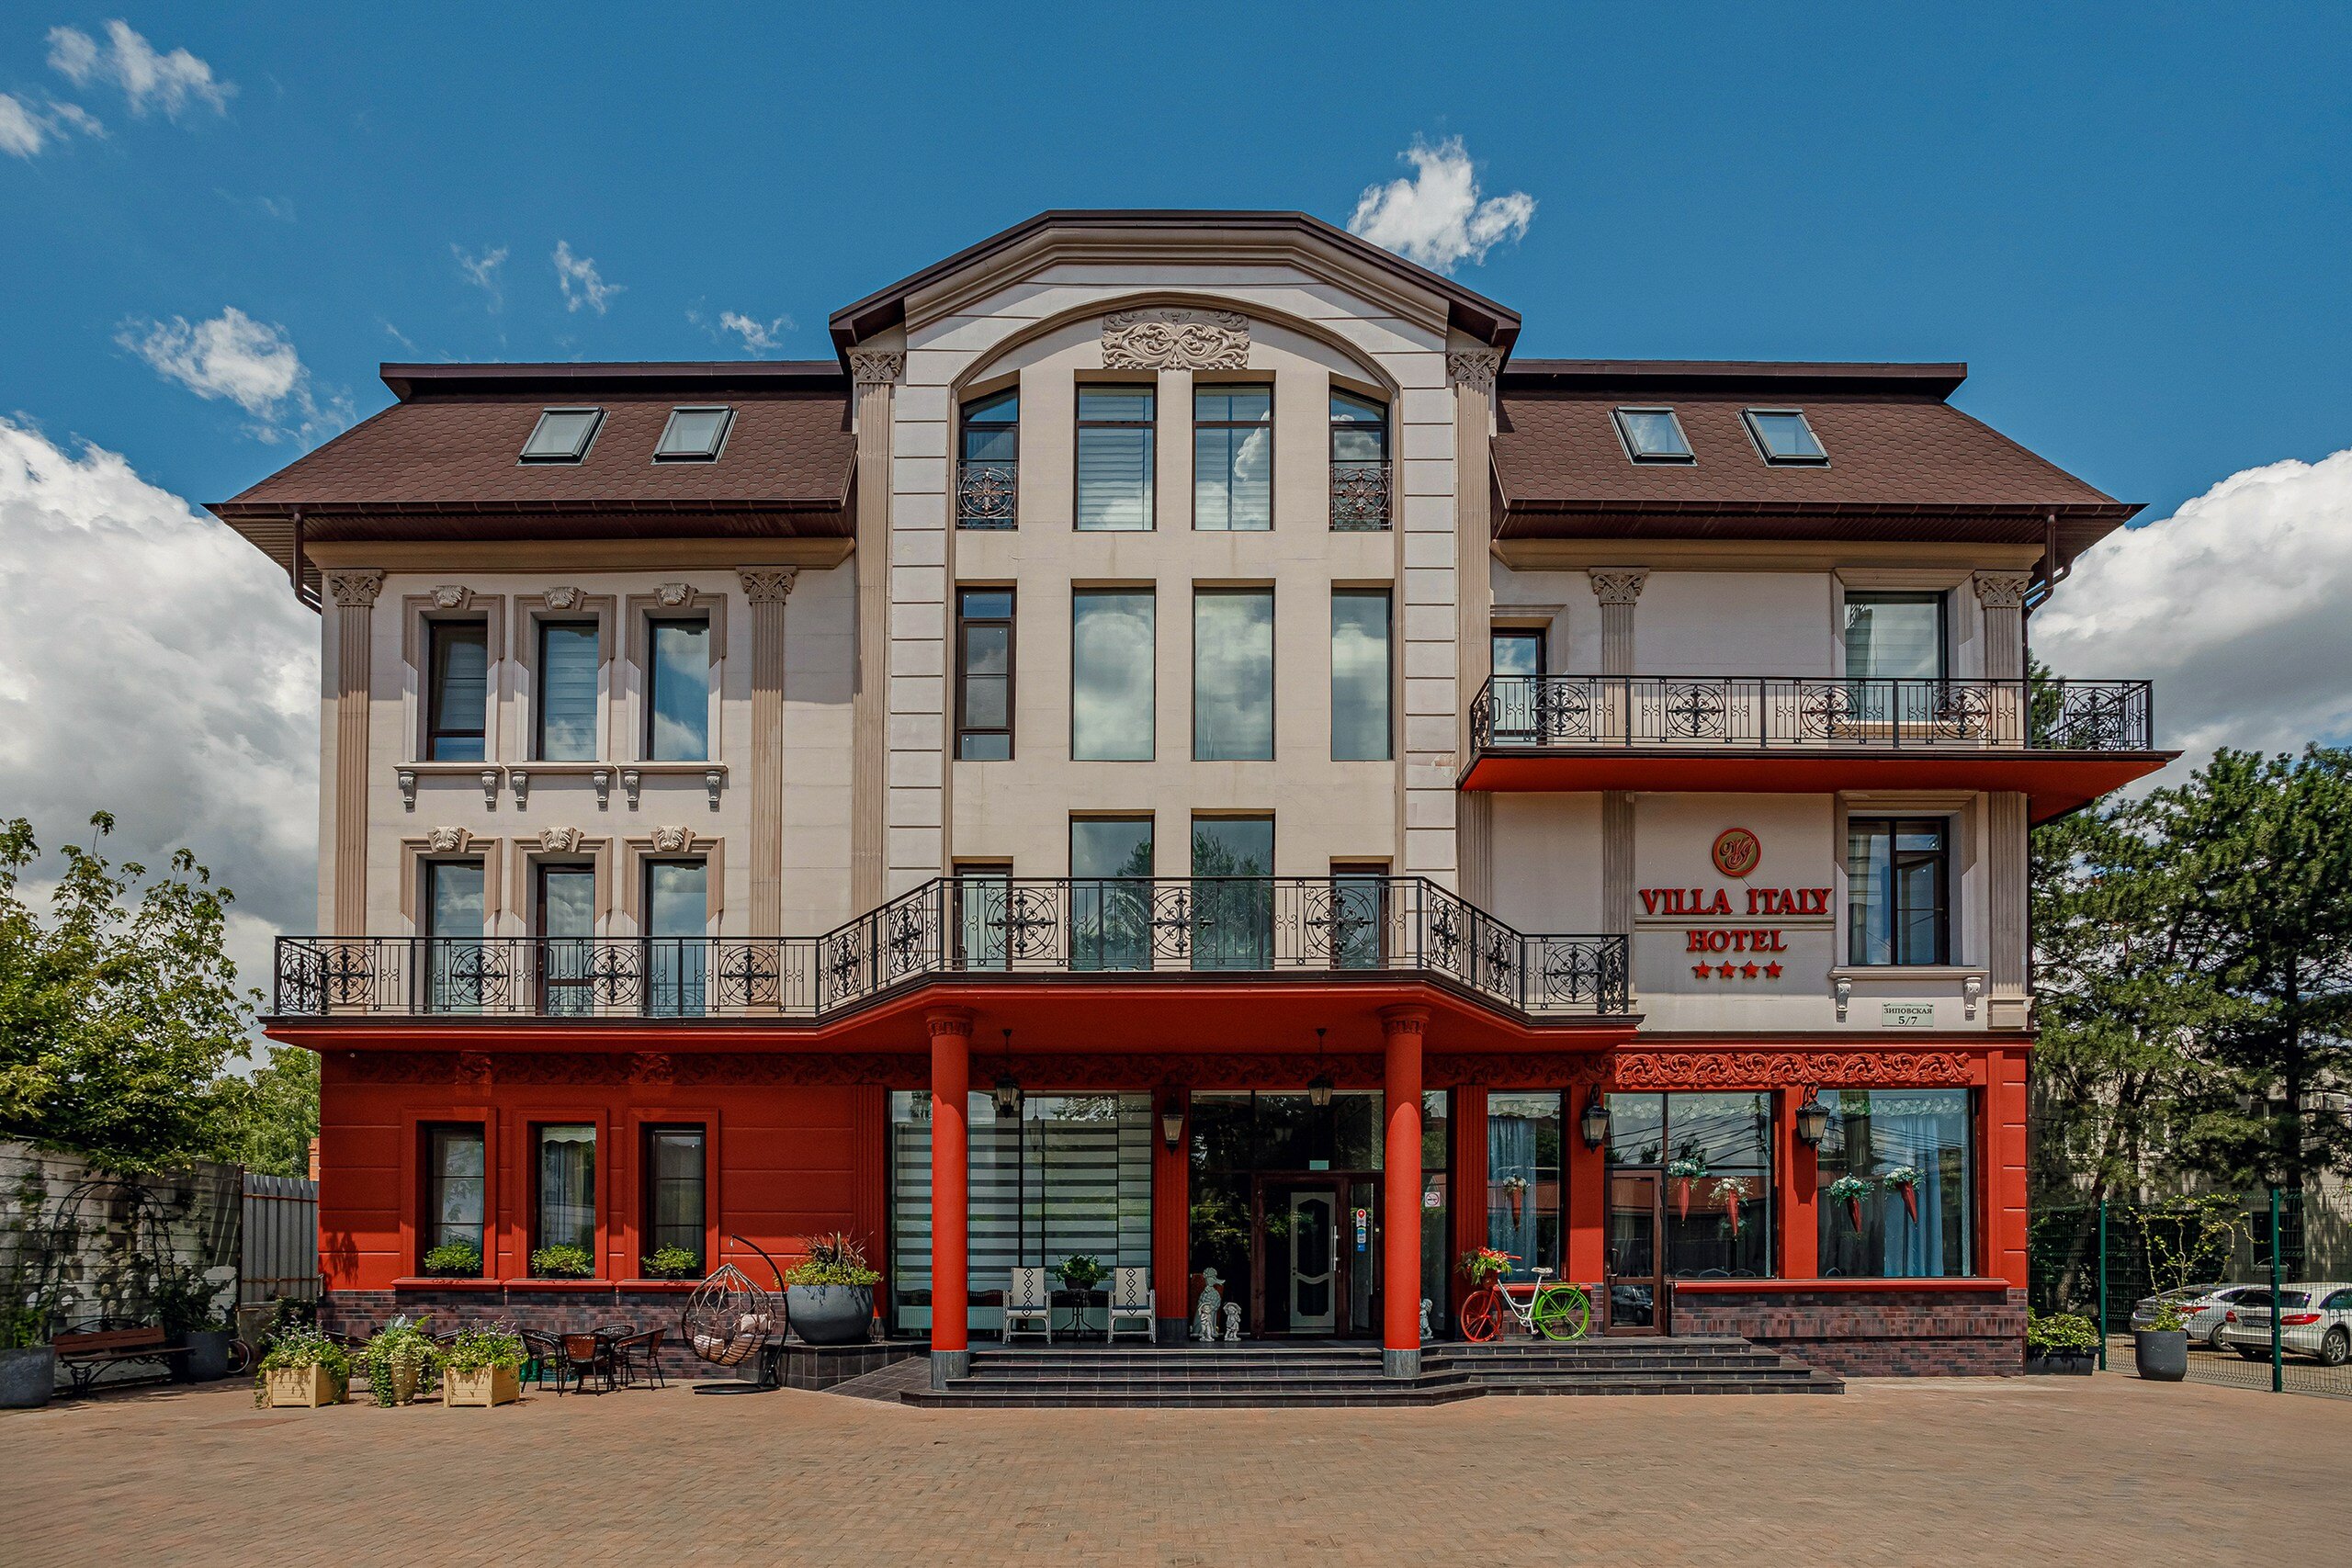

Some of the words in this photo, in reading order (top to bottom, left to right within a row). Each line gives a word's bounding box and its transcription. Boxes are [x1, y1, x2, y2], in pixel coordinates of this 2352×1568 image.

[1639, 888, 1734, 915] VILLA
[1746, 888, 1833, 915] ITALY
[1686, 930, 1789, 952] HOTEL
[1898, 1015, 1918, 1026] 5/7
